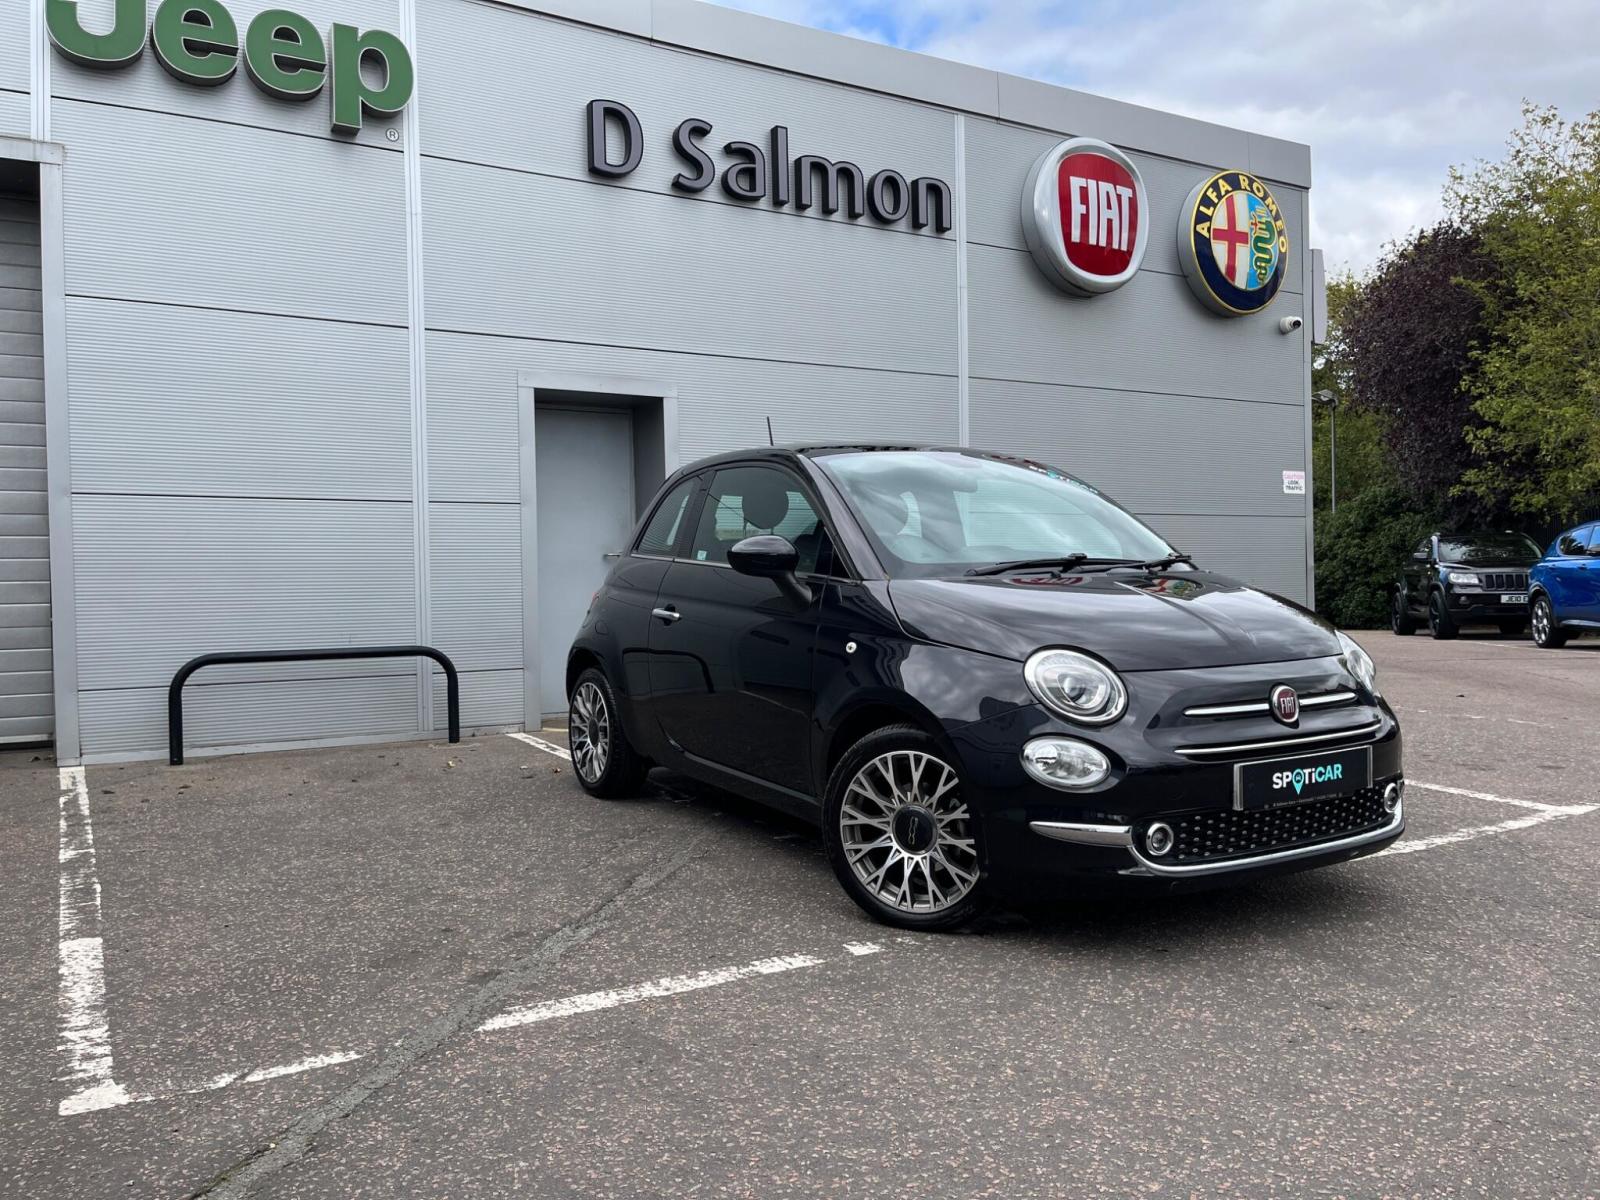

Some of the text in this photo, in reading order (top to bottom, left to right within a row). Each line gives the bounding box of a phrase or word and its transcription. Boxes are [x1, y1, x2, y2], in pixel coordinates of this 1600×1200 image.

[586, 99, 952, 233] D Salmon
[1069, 176, 1133, 252] FIAT
[1196, 174, 1287, 253] ALFA ROMEO
[1280, 696, 1295, 714] FIAT
